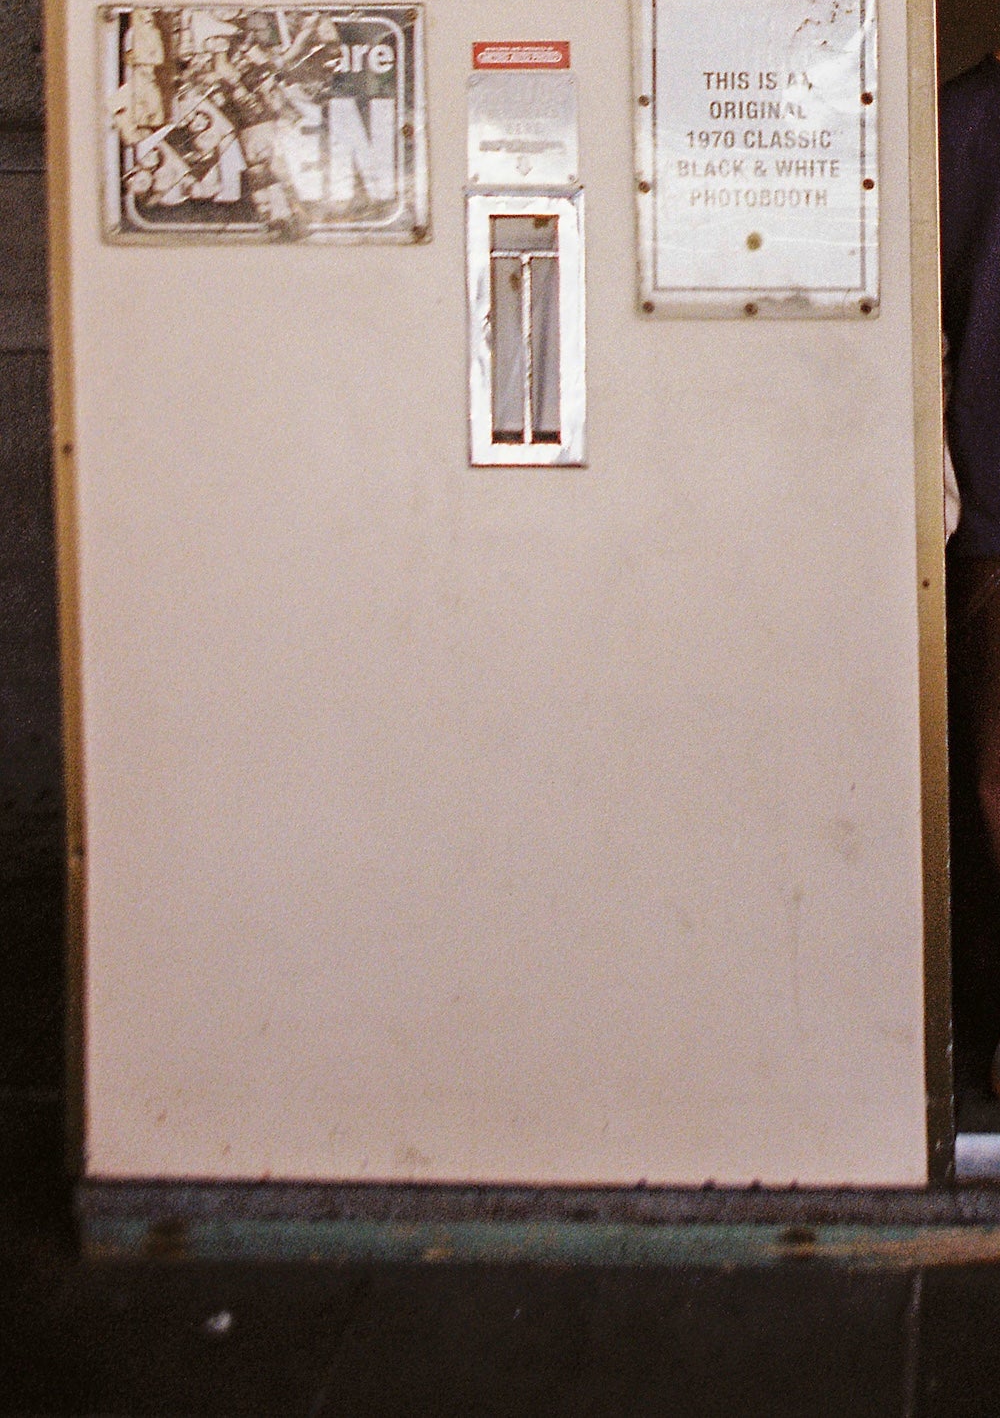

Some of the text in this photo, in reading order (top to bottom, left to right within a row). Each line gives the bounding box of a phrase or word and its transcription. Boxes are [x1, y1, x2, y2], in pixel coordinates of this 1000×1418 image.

[704, 72, 749, 90] THIS
[759, 72, 777, 89] IS
[710, 101, 807, 119] ORIGINAL
[686, 130, 832, 148] 1970 CLASSIC
[677, 159, 841, 177] BLACK & WHITE
[690, 189, 828, 207] PHOTOBOOTH
